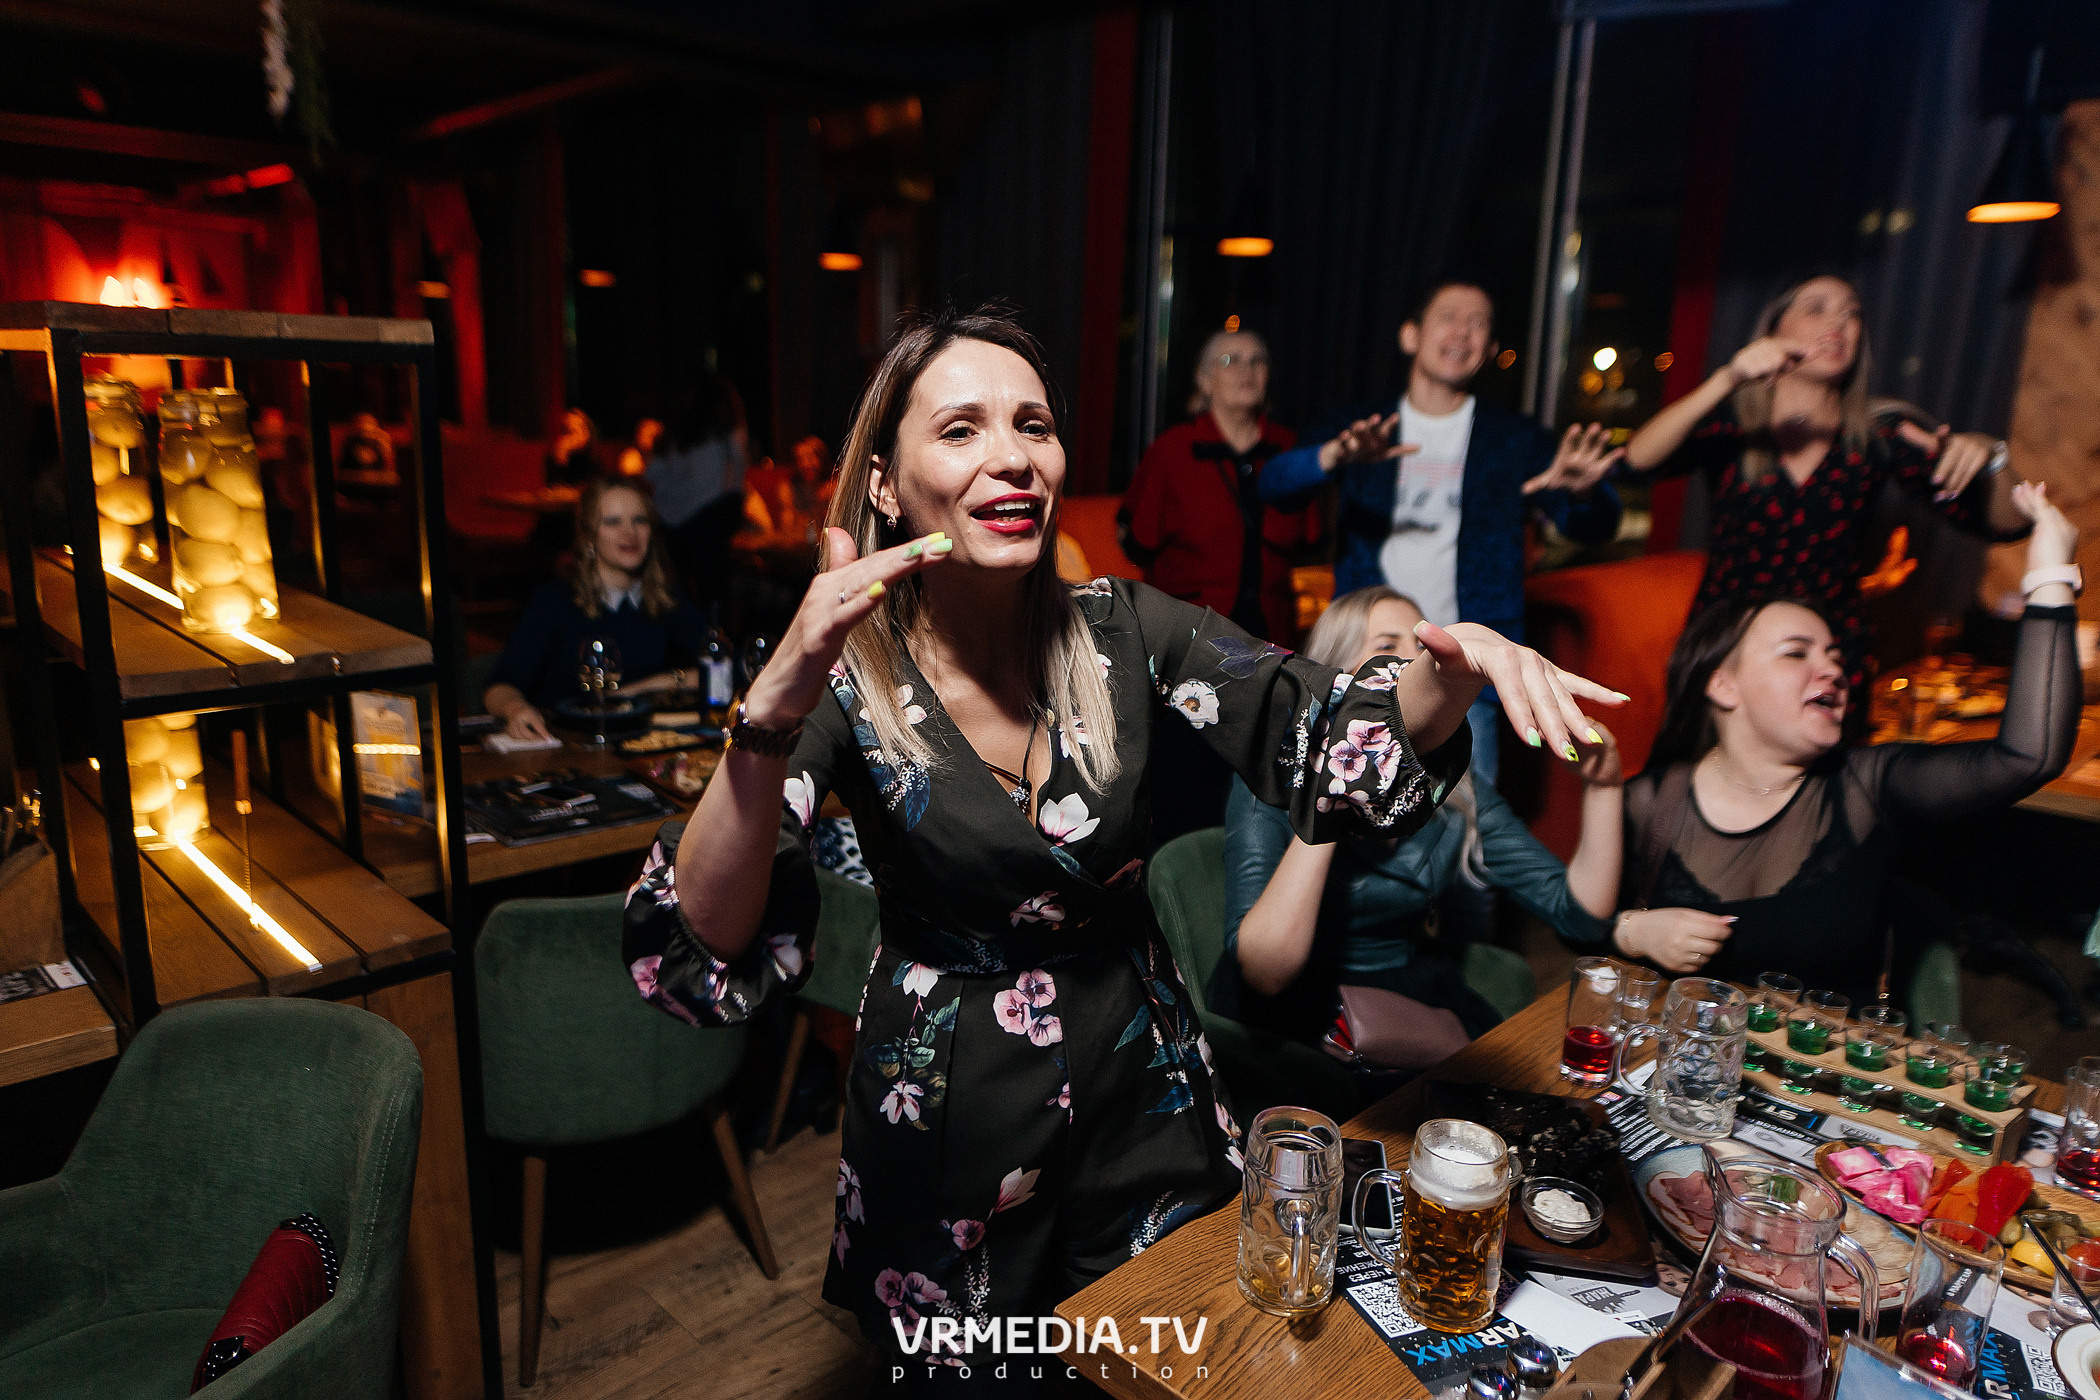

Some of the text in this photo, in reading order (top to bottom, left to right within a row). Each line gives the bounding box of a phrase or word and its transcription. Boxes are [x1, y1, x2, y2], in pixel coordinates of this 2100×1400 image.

[1335, 1259, 1383, 1275] ОЖЕНИЕ
[1348, 1269, 1386, 1283] ЧЕРЕЗ
[1405, 1321, 1530, 1367] ARMAX
